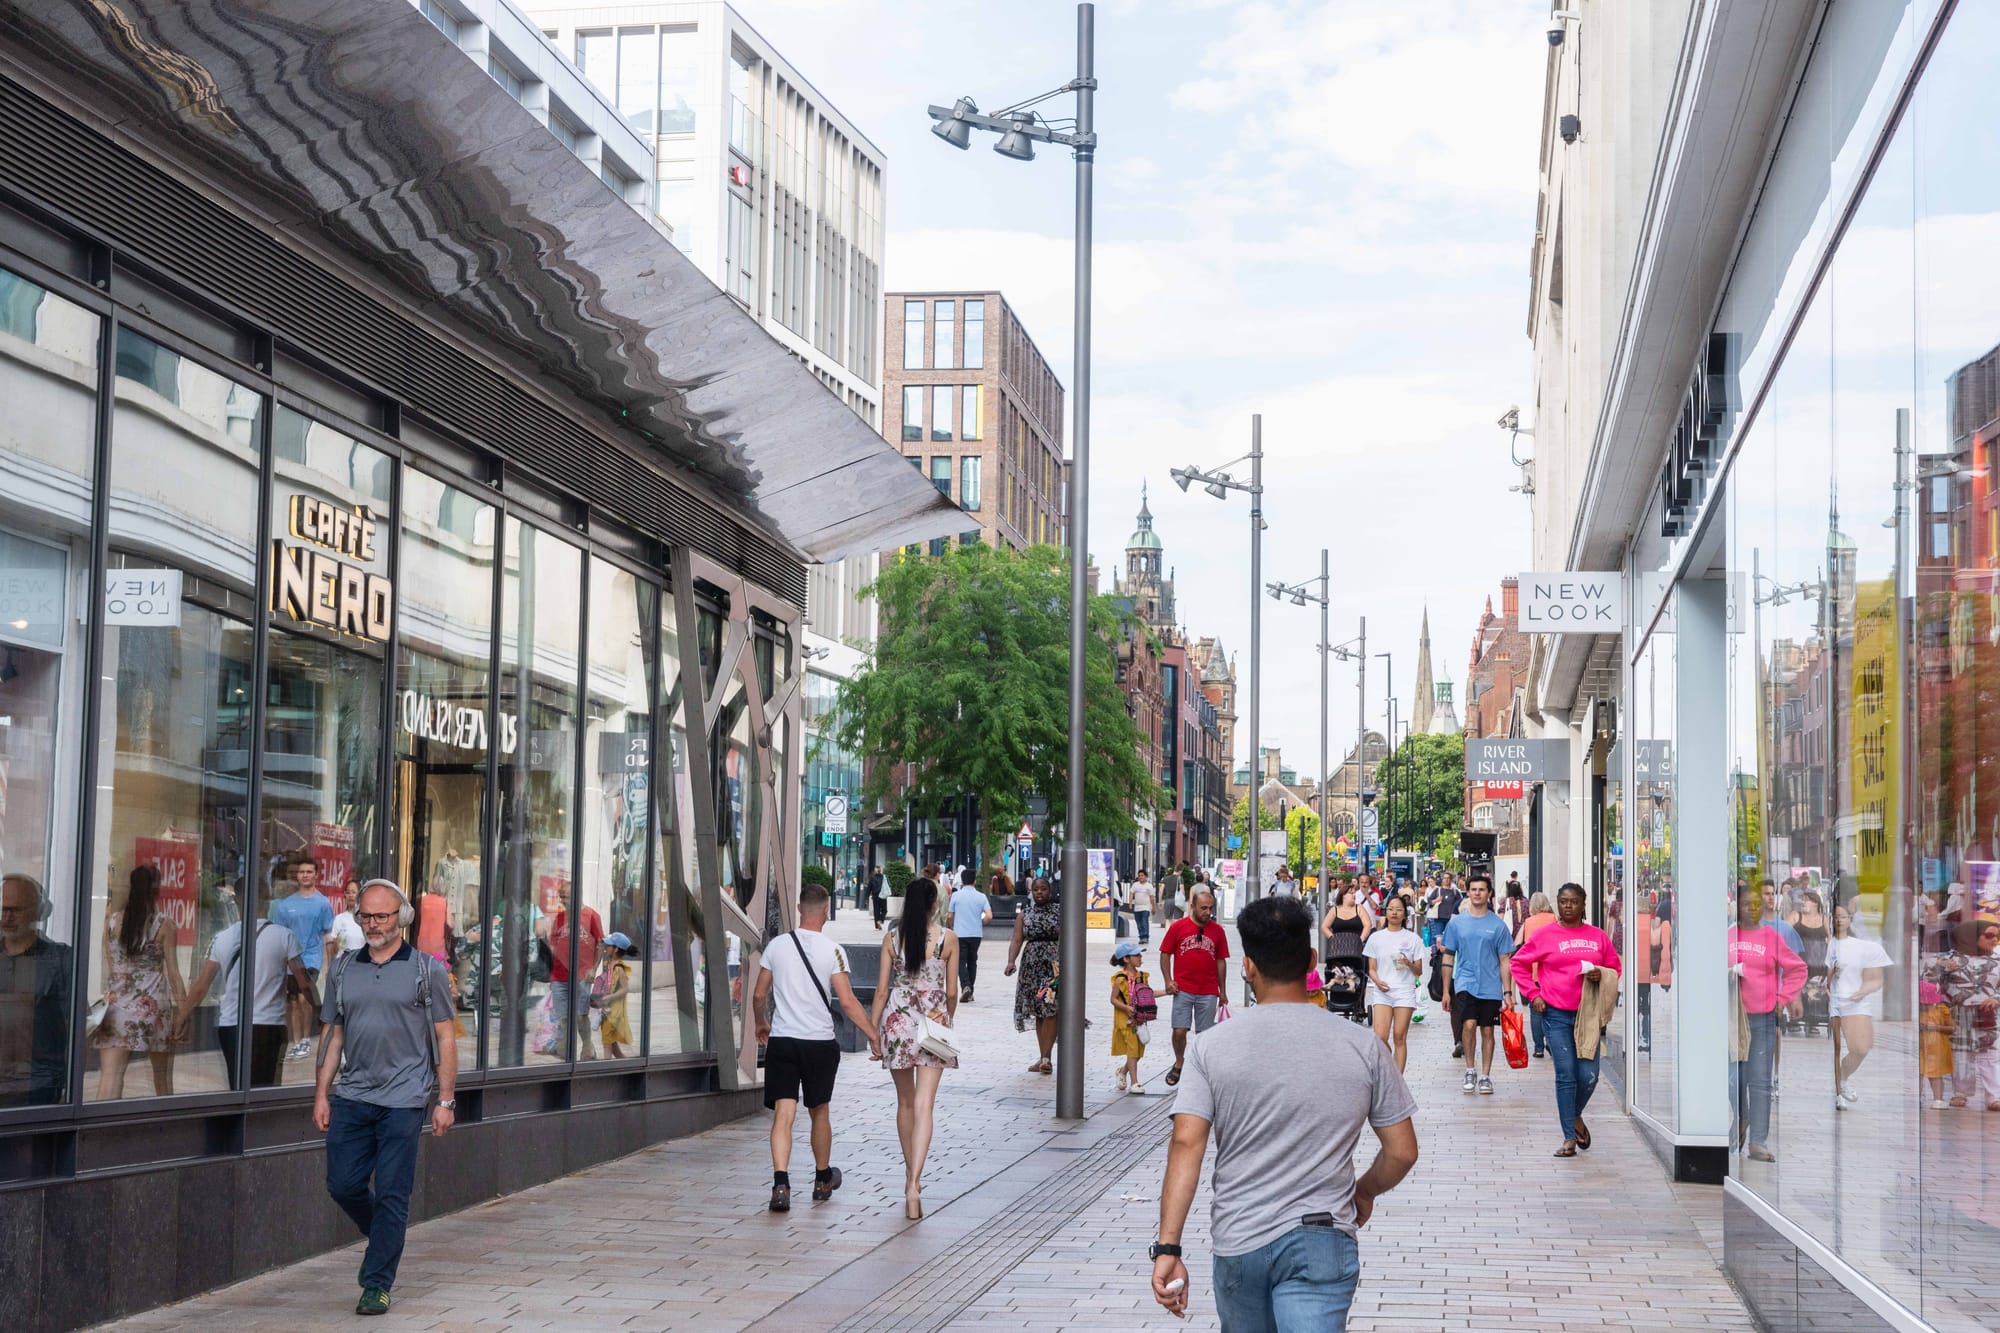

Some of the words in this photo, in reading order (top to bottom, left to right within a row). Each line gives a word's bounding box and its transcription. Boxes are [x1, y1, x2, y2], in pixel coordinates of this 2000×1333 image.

[290, 495, 376, 561] CAFFÈ
[270, 539, 392, 643] NERO
[1535, 584, 1605, 599] NEW
[1528, 605, 1612, 620] LOOK
[1863, 653, 1884, 718] NEW
[1483, 745, 1526, 758] RIVER
[1863, 725, 1885, 788] SALE
[1478, 761, 1532, 774] ISLAND
[1487, 780, 1520, 789] GUYS
